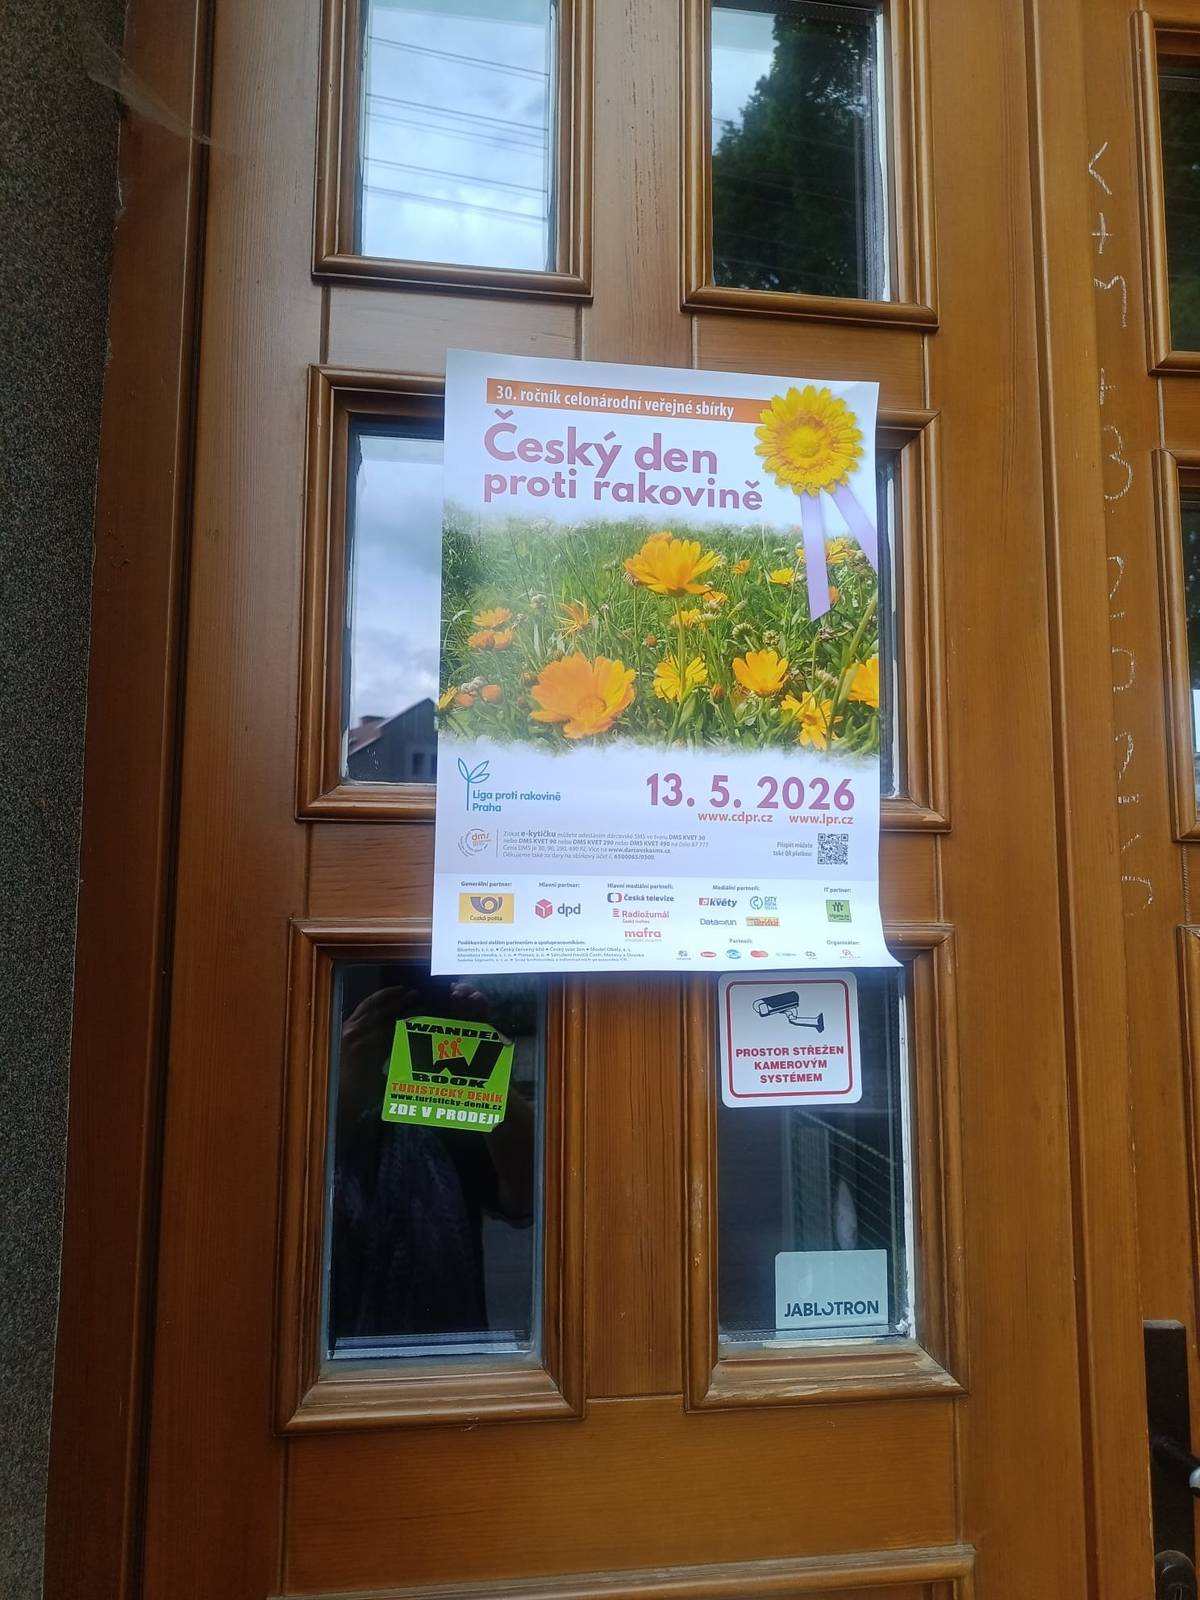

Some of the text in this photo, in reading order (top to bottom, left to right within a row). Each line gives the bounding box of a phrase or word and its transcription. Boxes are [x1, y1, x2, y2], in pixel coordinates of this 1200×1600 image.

[496, 385, 734, 420] 30. ročník celonárodní veřejné sbírky
[484, 408, 718, 478] Český den
[484, 468, 763, 510] proti rakovině
[472, 790, 561, 802] Liga proti rakovině
[646, 772, 855, 811] 13. 5. 2026
[472, 803, 502, 812] Praha
[698, 812, 854, 826] www.cdpr.cz www.lpr.cz
[472, 832, 490, 840] dms
[520, 829, 556, 839] e-kytičku
[558, 903, 581, 917] dpd
[710, 898, 738, 908] květy
[622, 910, 669, 918] Radiožurnál
[624, 928, 662, 938] mafra
[736, 1044, 844, 1058] PROSTOR STŘEŽEN
[754, 1058, 828, 1070] KAMEROVÝM
[412, 1072, 489, 1089] BOOK
[760, 1072, 822, 1084] SYSTÉMEM
[390, 1093, 502, 1111] www.turisticky-denik.cz
[389, 1103, 417, 1116] ZDE
[422, 1106, 432, 1118] V
[784, 1300, 879, 1318] JABLOTRON
